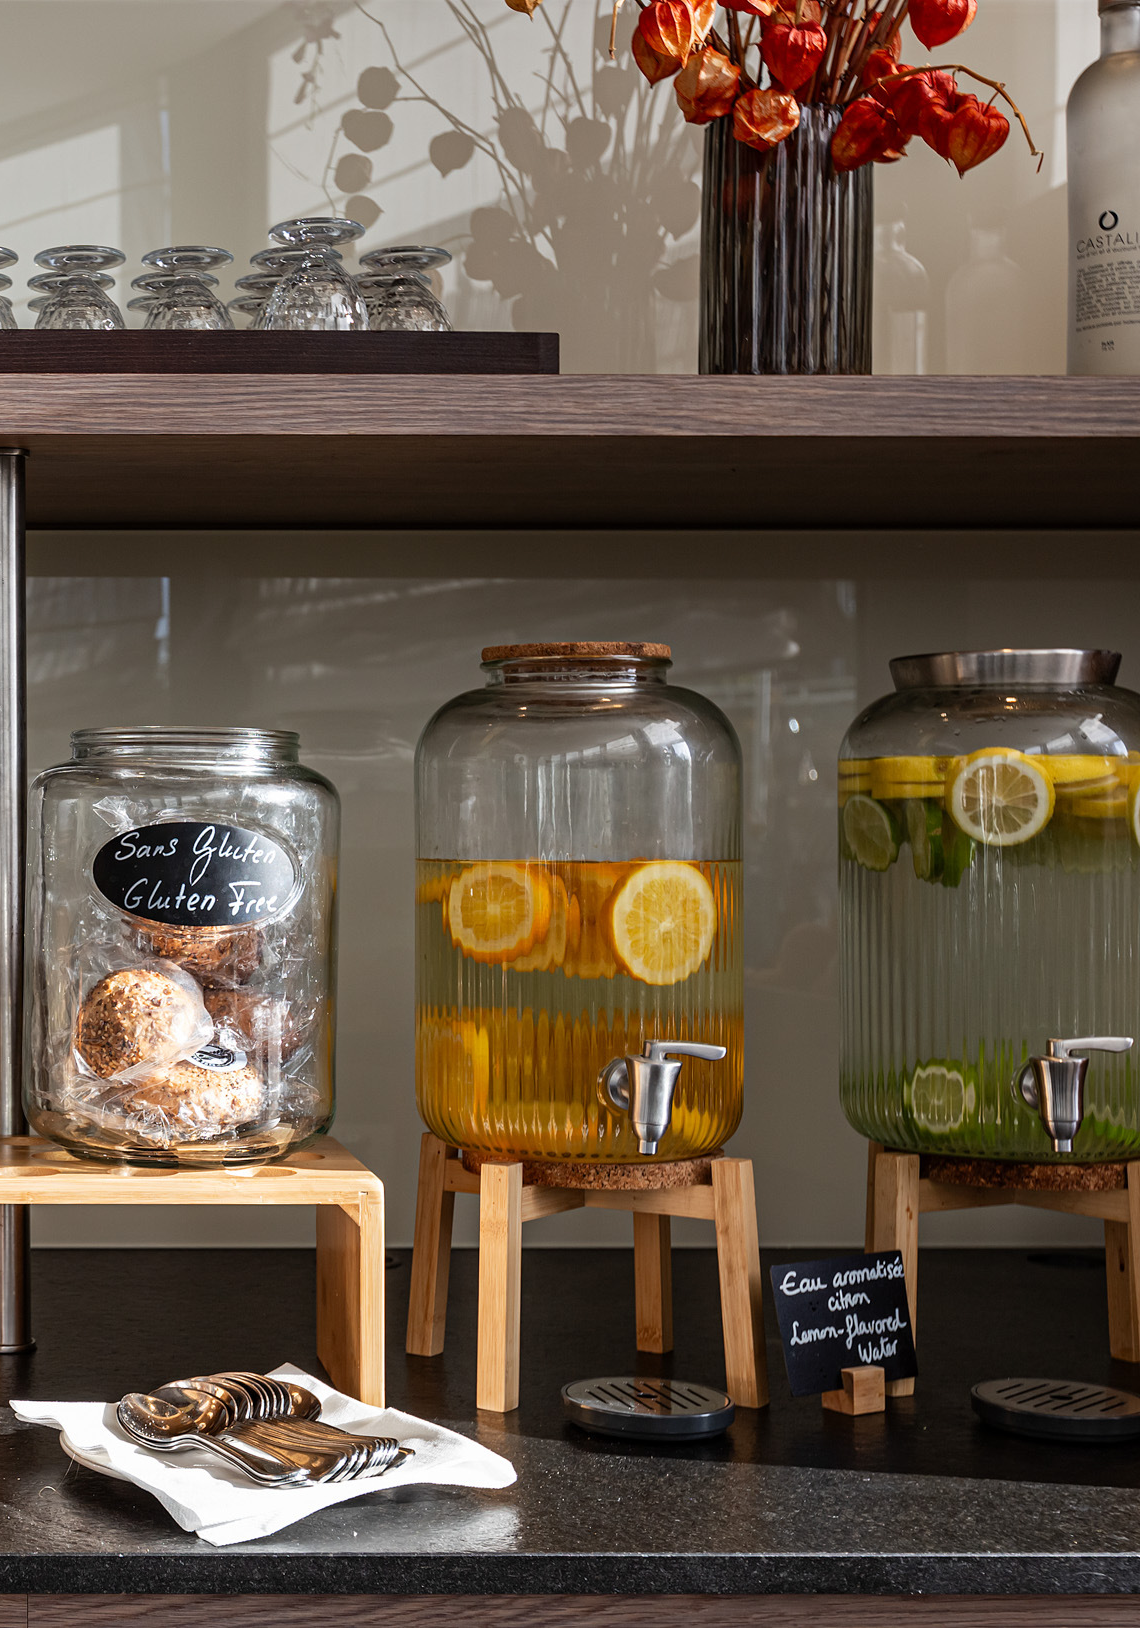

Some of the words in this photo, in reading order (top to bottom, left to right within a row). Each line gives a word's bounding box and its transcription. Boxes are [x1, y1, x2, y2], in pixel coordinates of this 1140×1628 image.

[1076, 231, 1139, 253] CASTALI
[114, 832, 179, 861] Sans
[123, 878, 216, 911] Gluten
[229, 881, 279, 916] Free
[780, 1271, 827, 1296] Eau
[832, 1256, 905, 1288] aromatisée
[828, 1289, 871, 1312] citron
[790, 1307, 907, 1350] Lemon-flavored
[858, 1336, 898, 1364] Water
